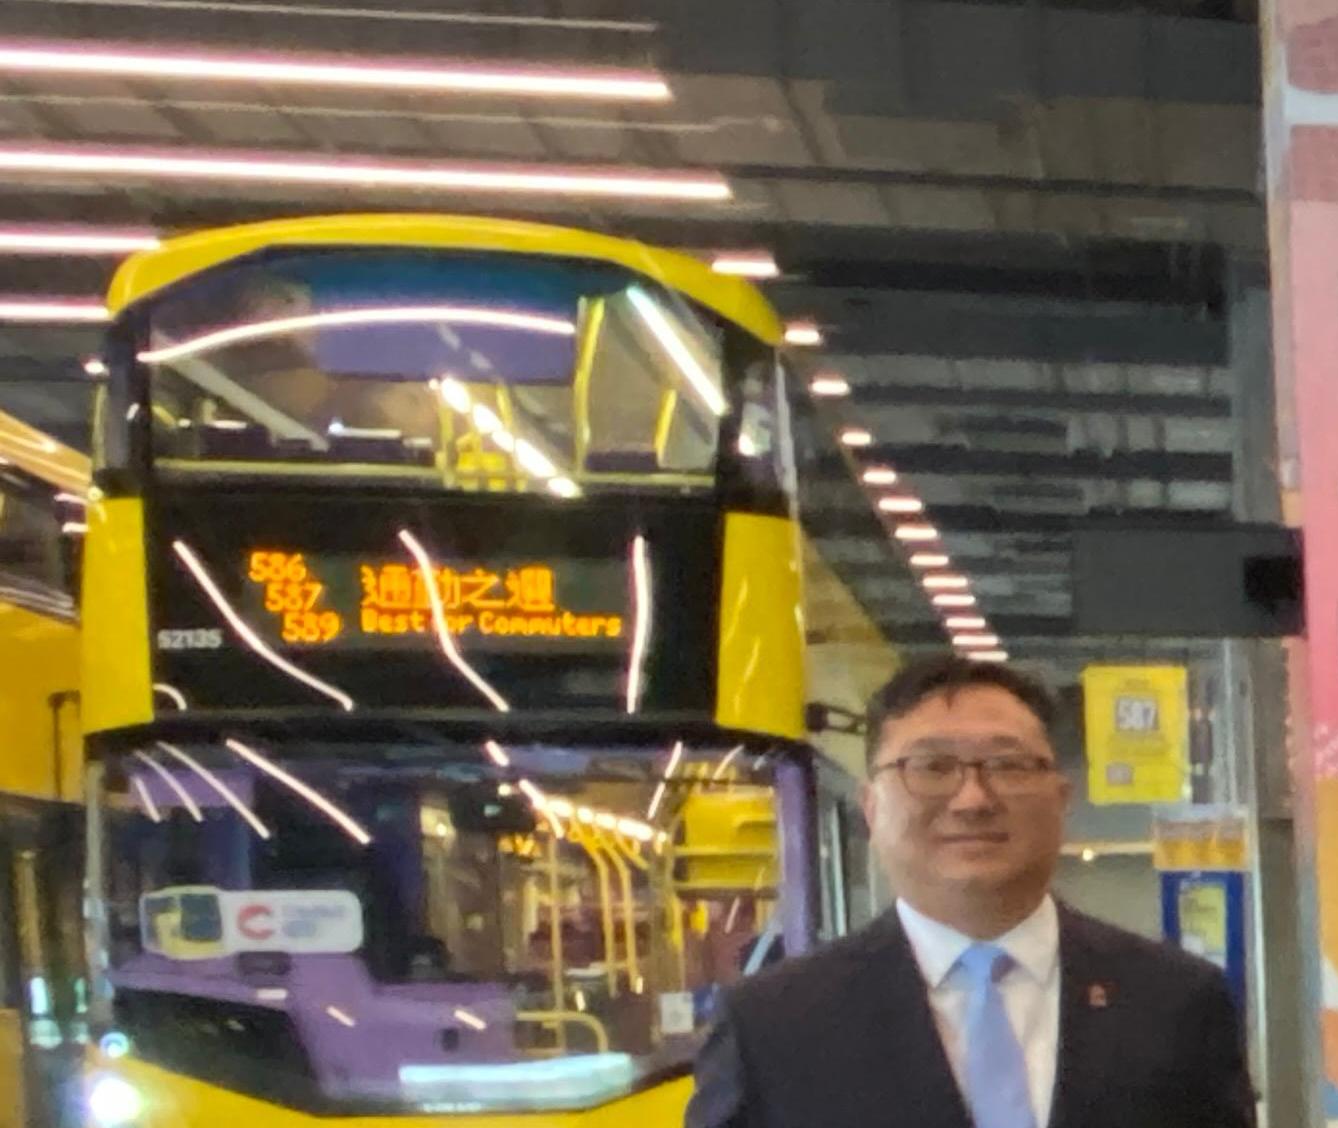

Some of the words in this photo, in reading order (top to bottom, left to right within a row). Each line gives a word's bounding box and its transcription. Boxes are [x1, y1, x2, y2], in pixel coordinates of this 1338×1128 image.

[249, 551, 307, 583] 586
[265, 583, 323, 613] 587
[282, 612, 341, 644] 589
[479, 611, 622, 638] Commuters
